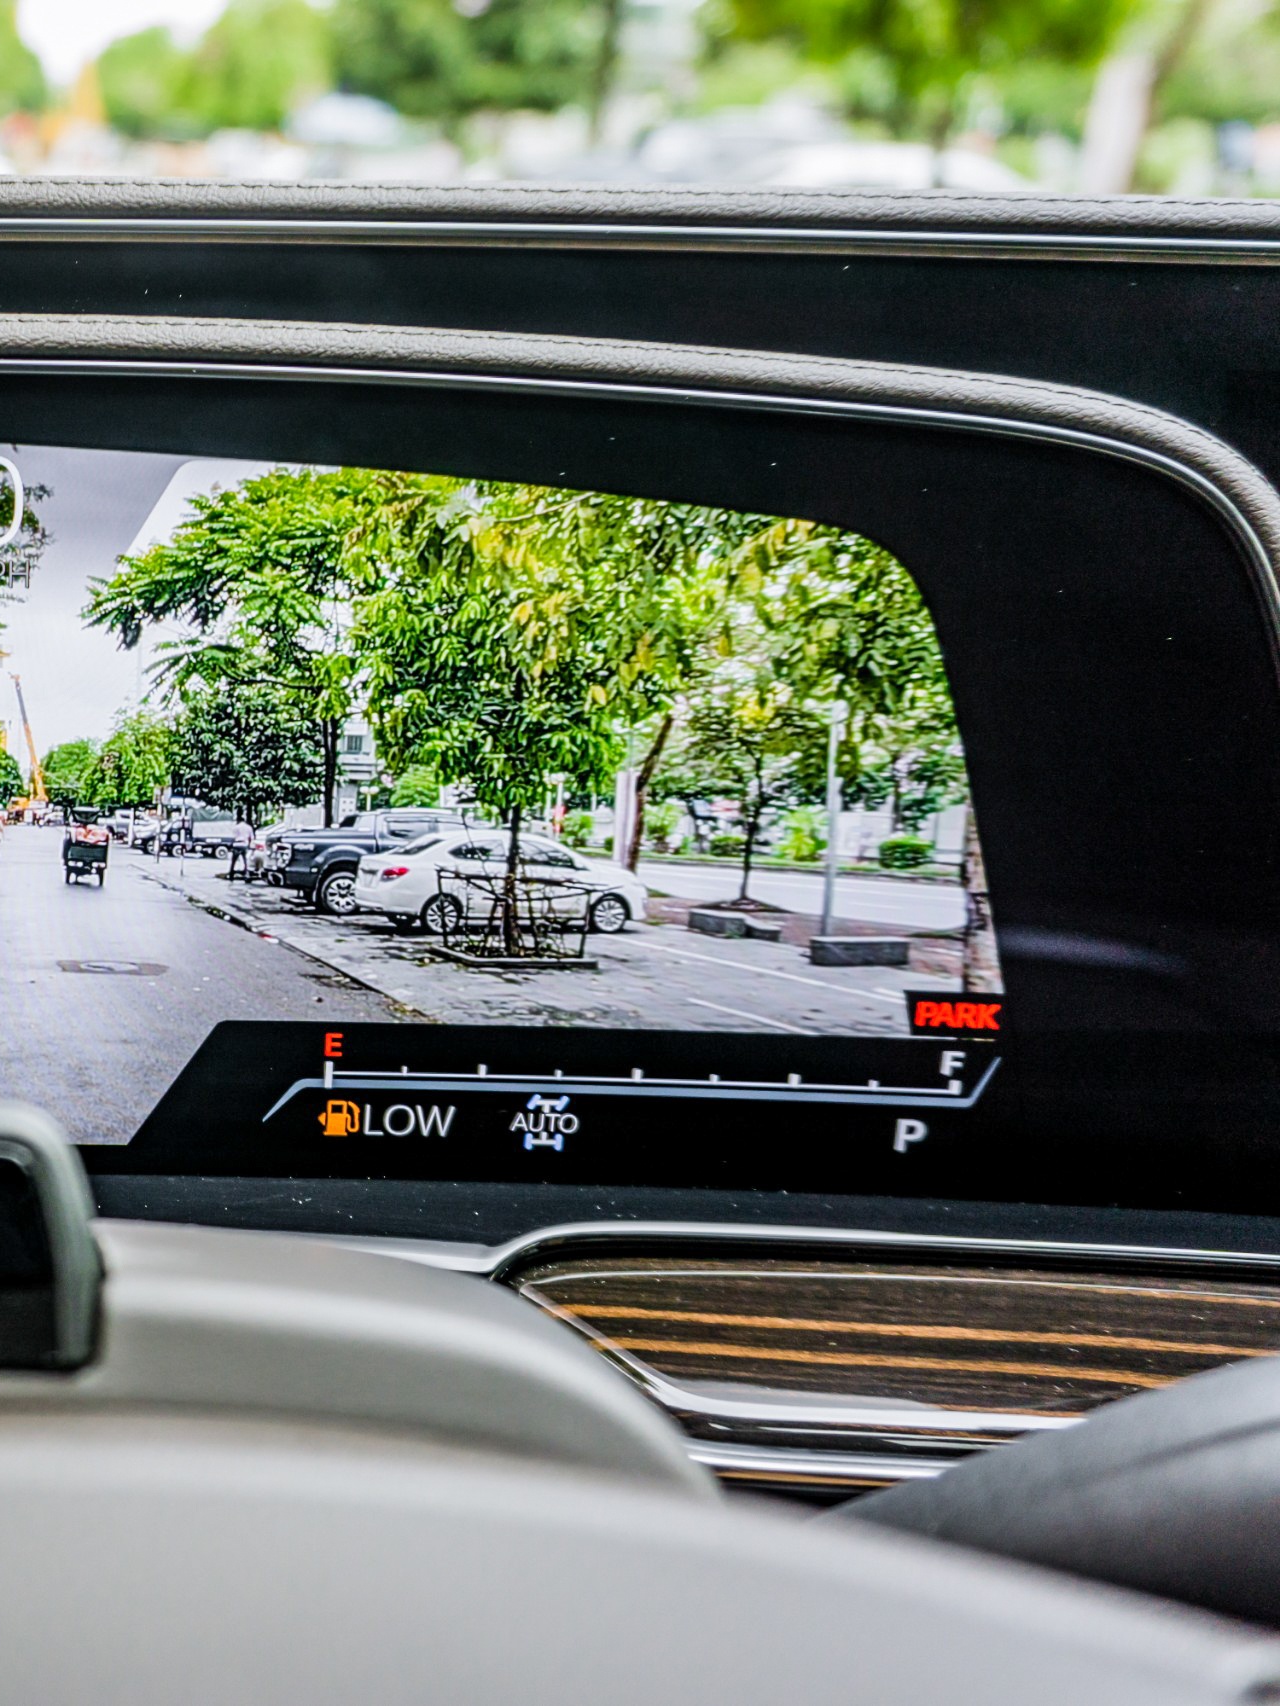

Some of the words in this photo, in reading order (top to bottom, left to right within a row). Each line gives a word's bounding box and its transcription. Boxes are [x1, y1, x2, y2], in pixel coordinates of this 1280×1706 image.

[914, 1001, 1001, 1030] PARK
[324, 1033, 344, 1057] E
[939, 1051, 966, 1077] F
[363, 1104, 456, 1137] LOW
[509, 1112, 579, 1133] AUTO
[893, 1118, 927, 1153] P
